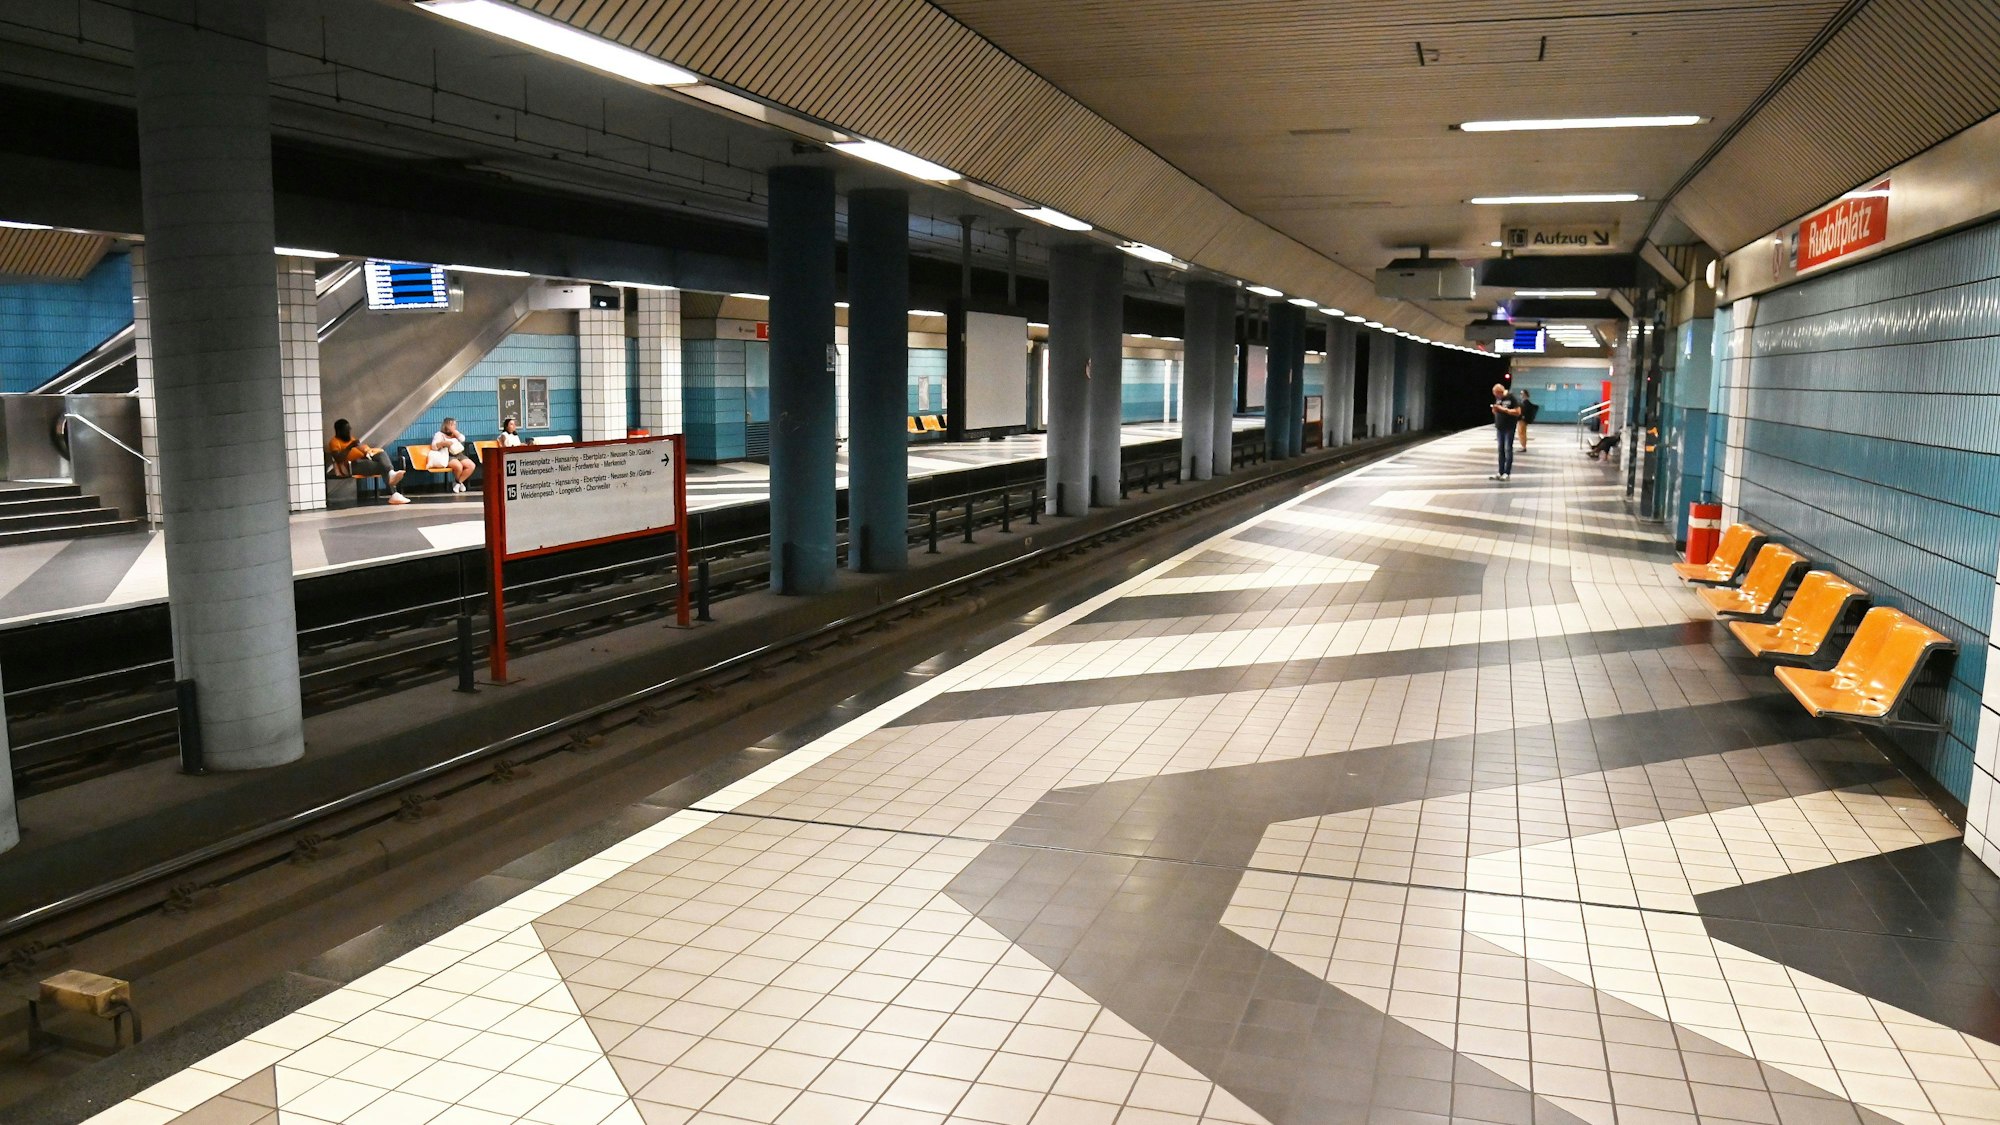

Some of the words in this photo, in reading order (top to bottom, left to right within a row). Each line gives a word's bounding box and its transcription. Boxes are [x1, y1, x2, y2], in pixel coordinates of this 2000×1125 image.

[1808, 202, 1872, 259] Rudolfplatz
[1534, 232, 1587, 246] Aufzug
[520, 458, 550, 466] Friesenplatz
[583, 453, 606, 462] Ebertplatz
[507, 463, 516, 474] 12
[520, 467, 553, 476] Weidenpesch
[575, 463, 599, 471] Fordwerke
[604, 459, 626, 468] Merkenich
[520, 481, 551, 490] Friesenplatz
[555, 478, 579, 486] Hansaring
[584, 475, 606, 483] Ebertplatz
[508, 487, 516, 498] 15
[521, 489, 554, 499] Weidenpesch
[559, 486, 582, 495] Longerich
[586, 483, 610, 491] Chorweiler
